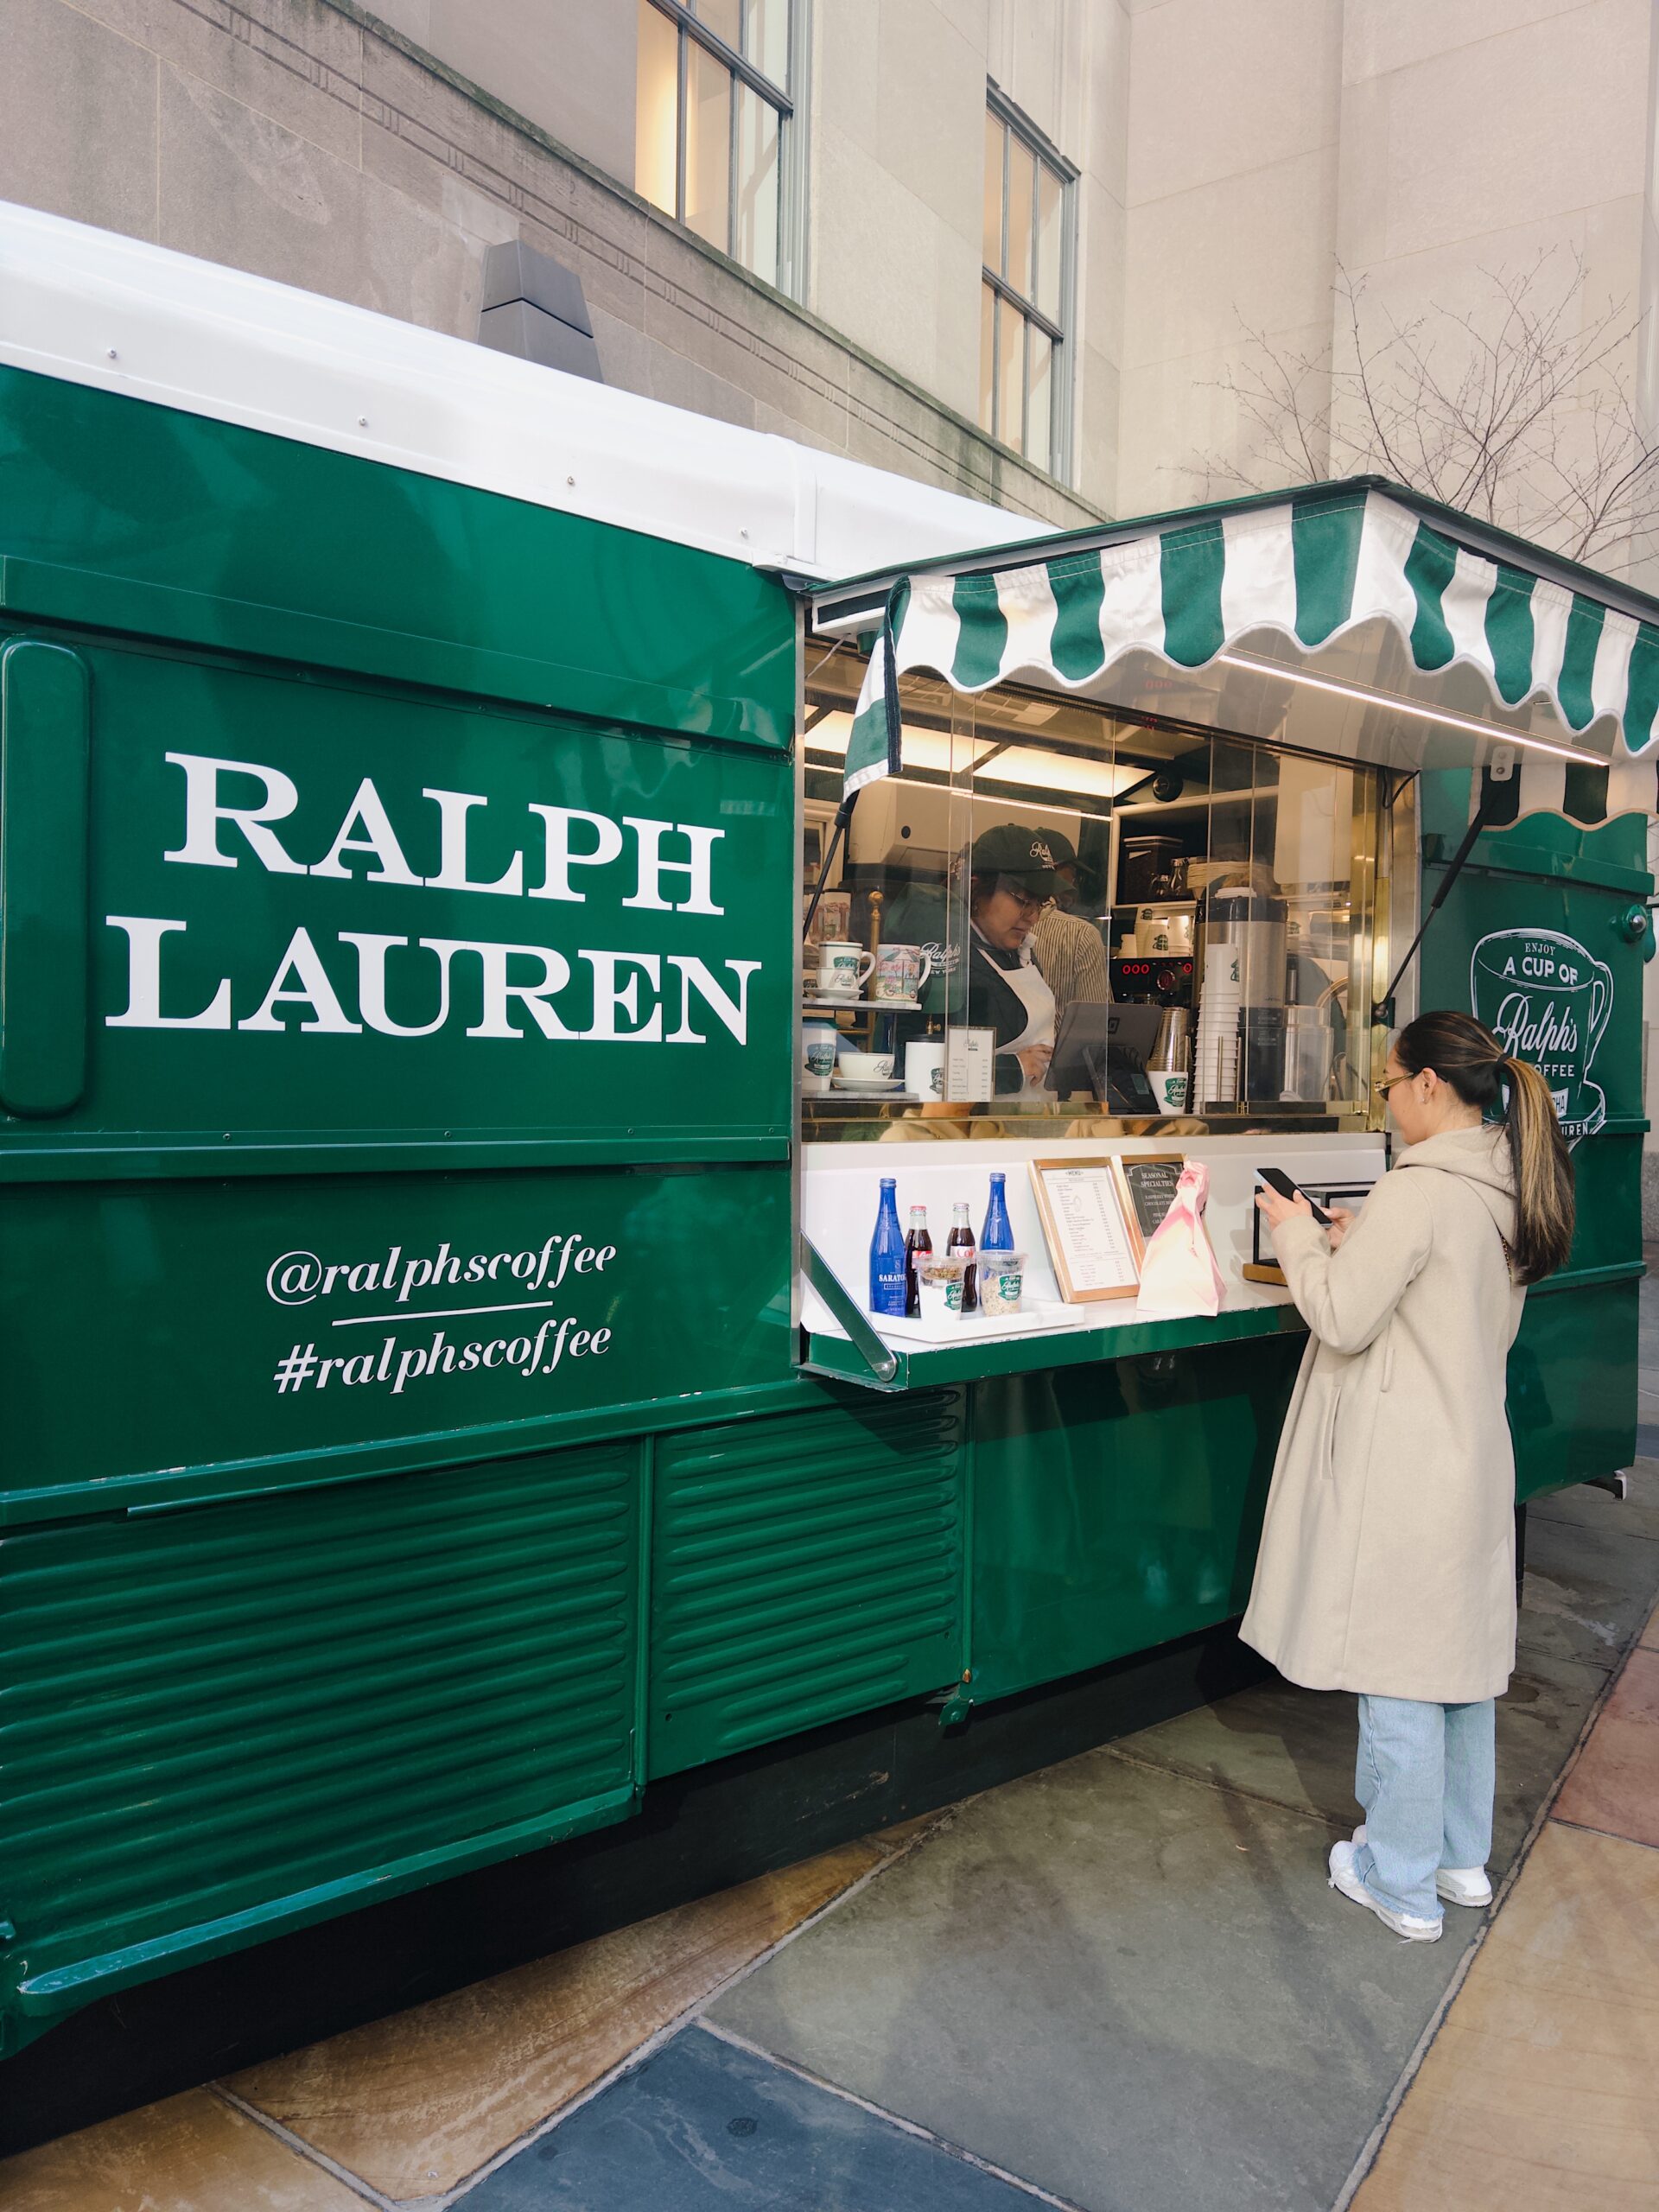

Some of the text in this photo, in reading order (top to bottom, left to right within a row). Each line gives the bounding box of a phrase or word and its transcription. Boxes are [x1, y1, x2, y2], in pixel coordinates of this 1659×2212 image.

[163, 752, 726, 916] RALPH
[1503, 957, 1579, 986] A CUP OF
[1525, 943, 1555, 956] ENJOY
[105, 915, 762, 1046] LAUREN
[1492, 992, 1578, 1062] Ralph's
[1535, 1064, 1574, 1077] OFFEE
[1561, 1122, 1588, 1135] UREN
[266, 1234, 616, 1306] @ralphscoffee
[879, 1274, 906, 1282] SARATO
[273, 1318, 612, 1395] #ralphscoffee
